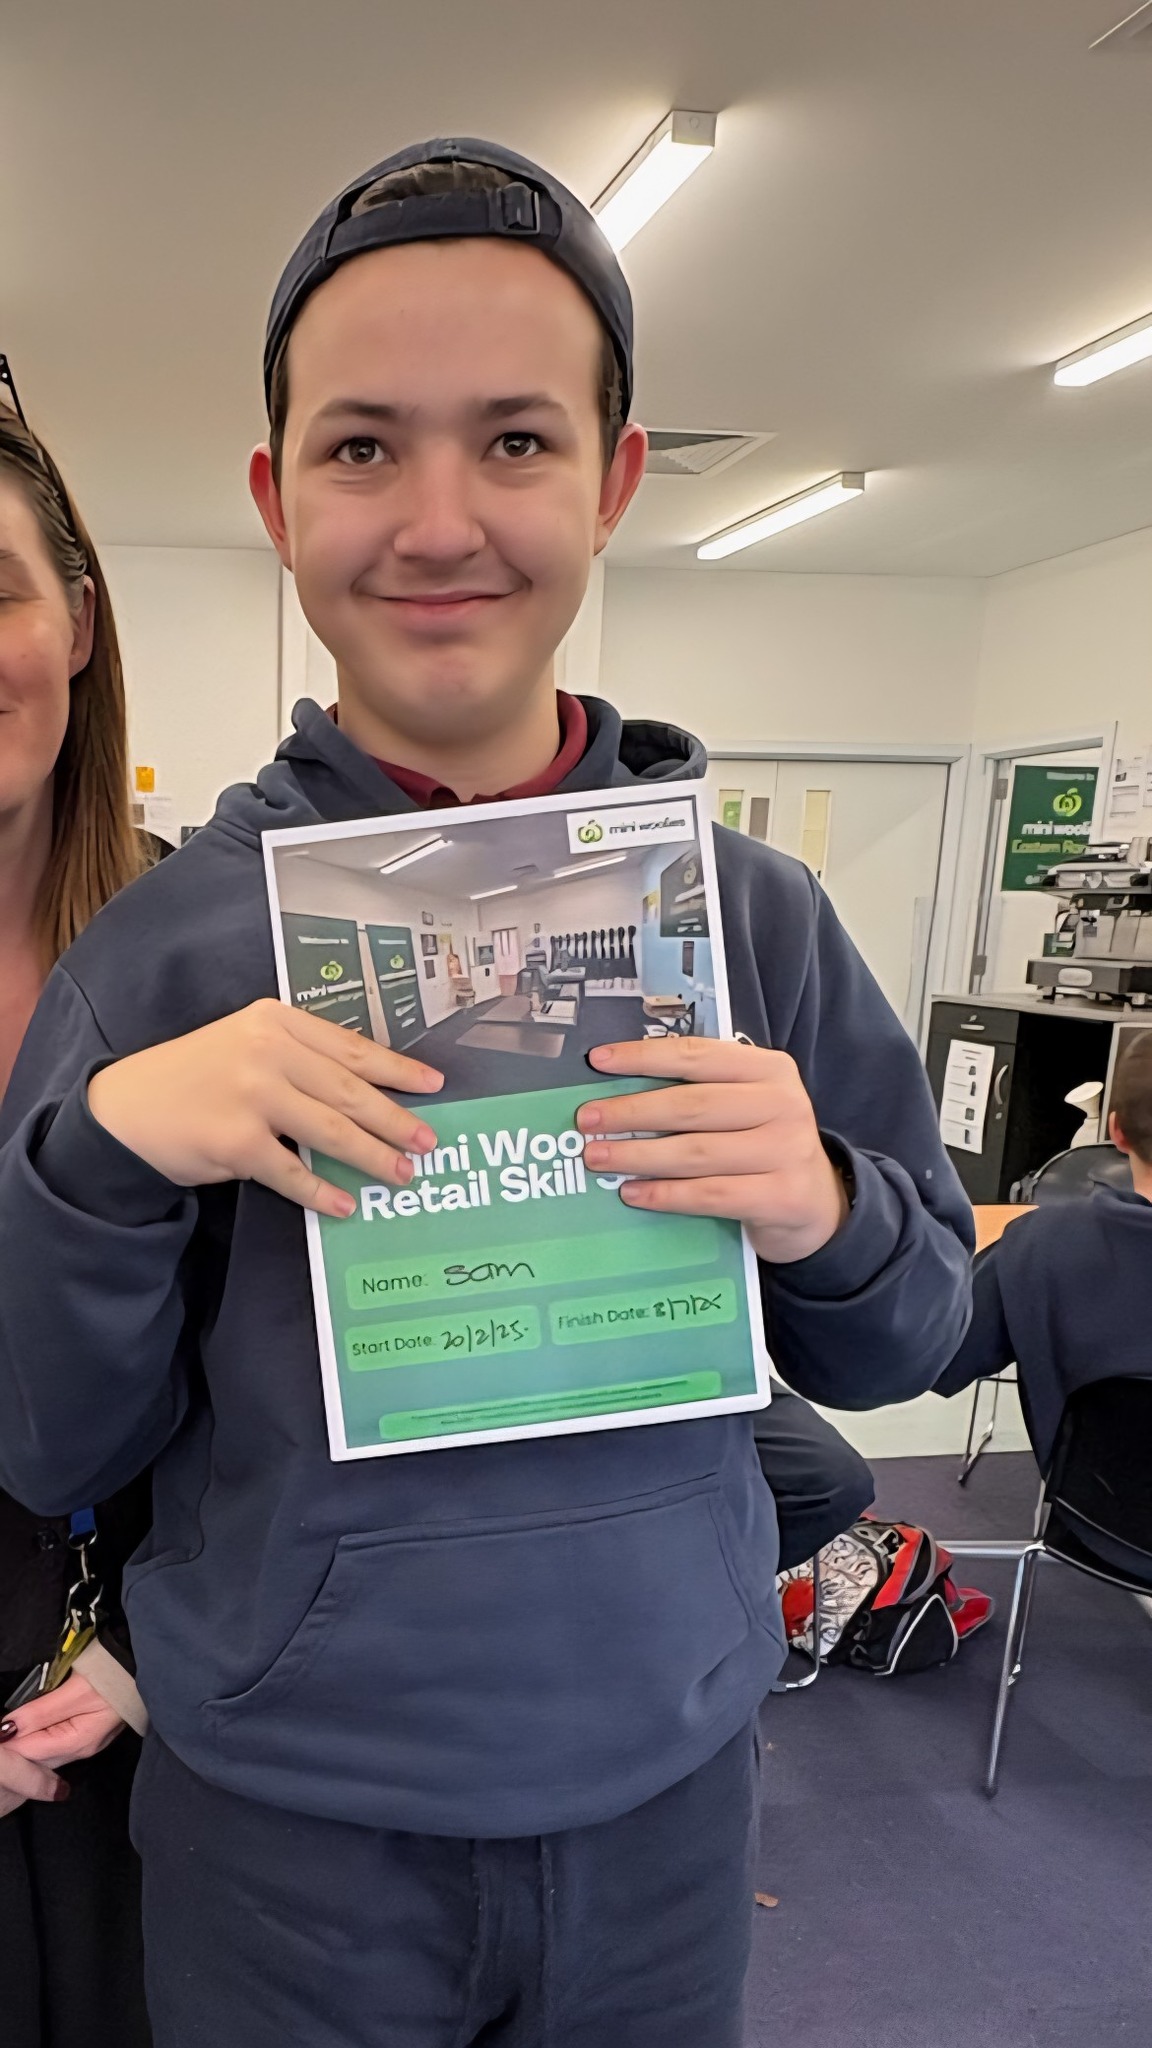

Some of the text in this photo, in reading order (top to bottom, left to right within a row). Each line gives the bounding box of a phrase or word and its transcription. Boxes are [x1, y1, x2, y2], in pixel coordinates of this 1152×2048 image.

[405, 1133, 471, 1177] ini
[360, 1156, 587, 1221] Retail Skill
